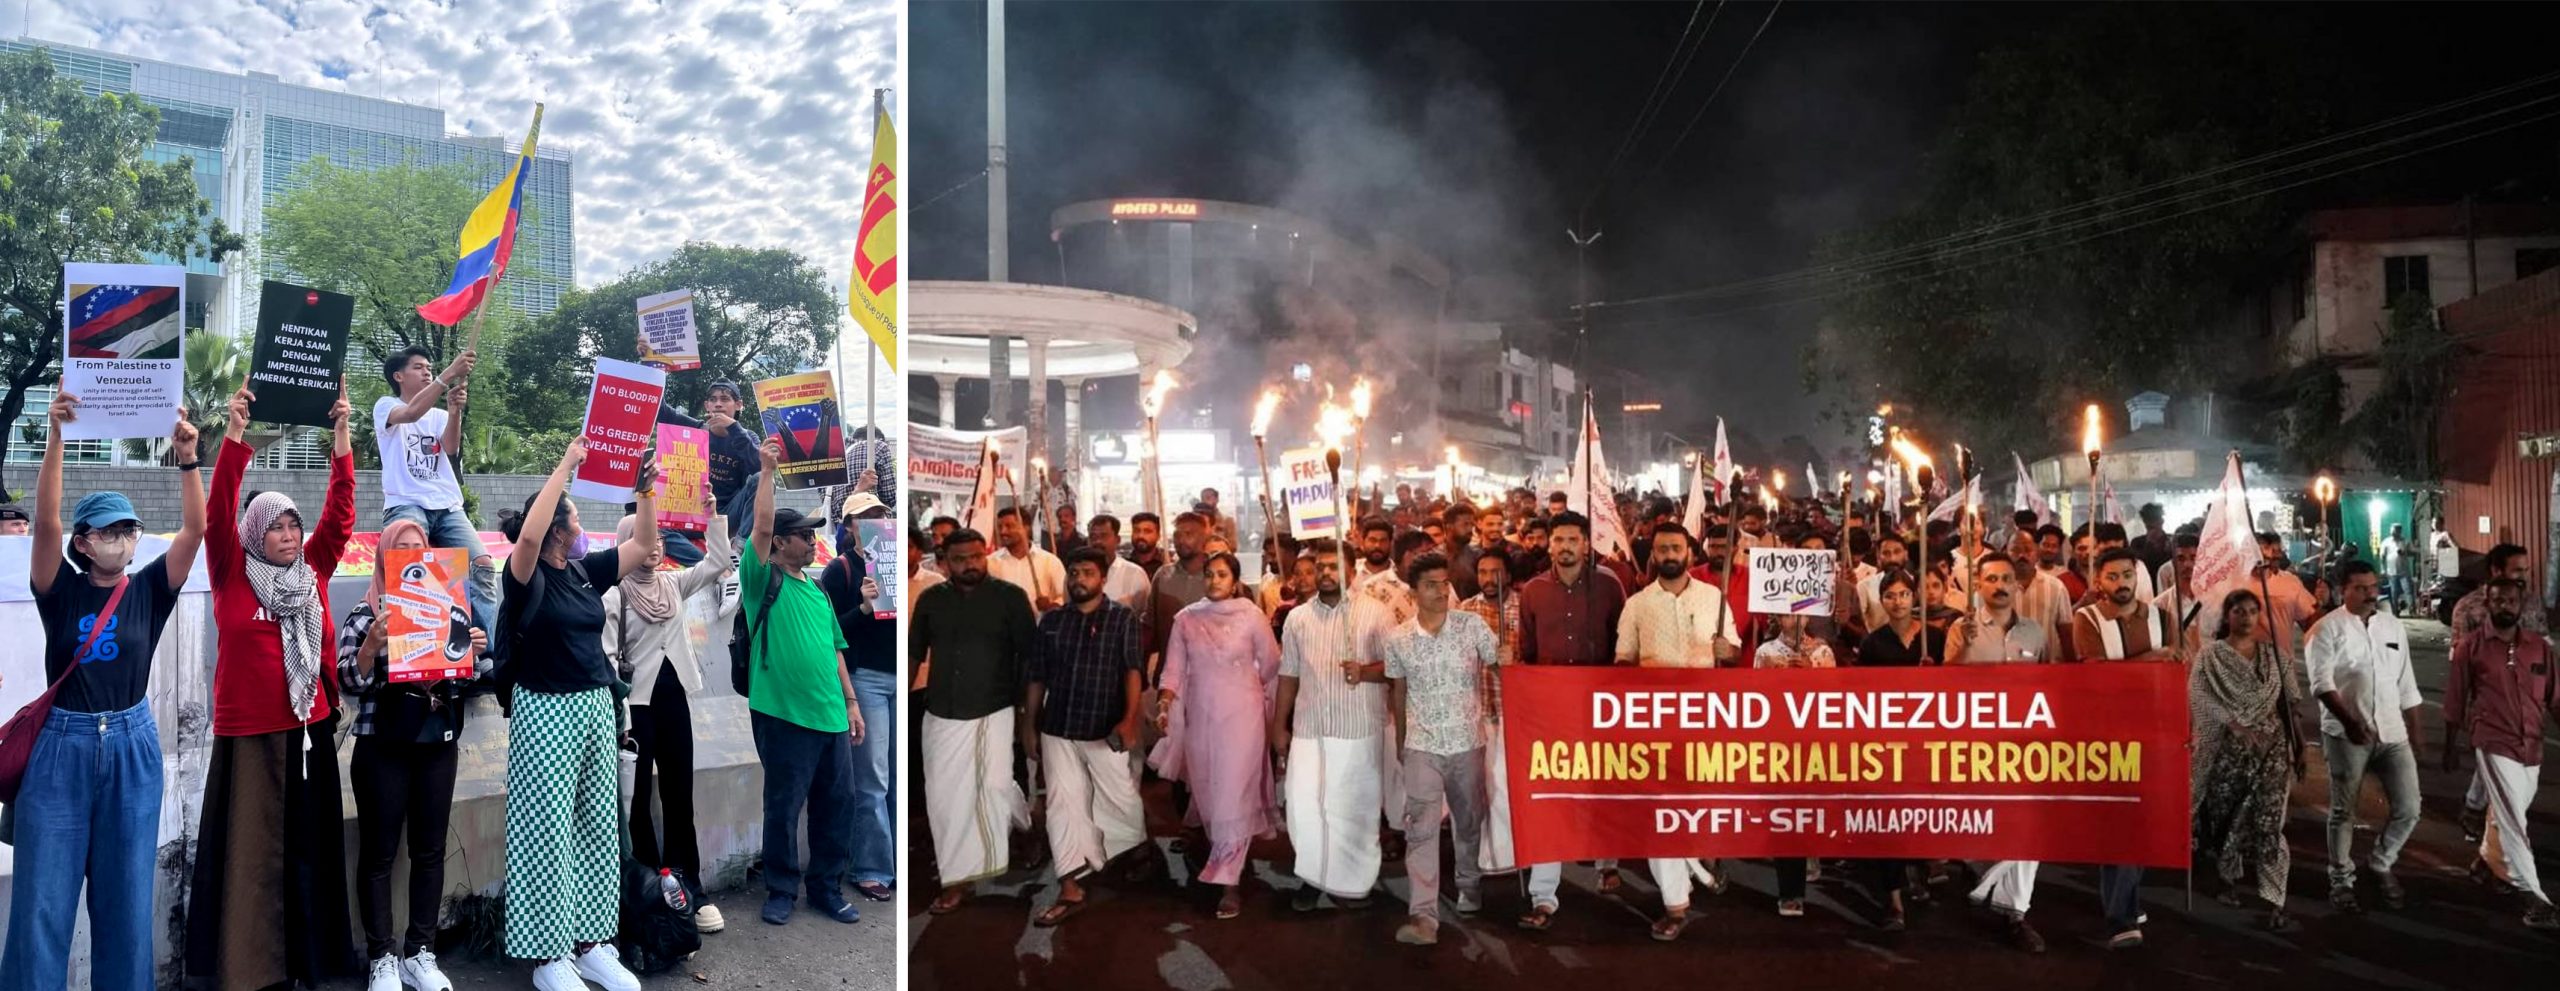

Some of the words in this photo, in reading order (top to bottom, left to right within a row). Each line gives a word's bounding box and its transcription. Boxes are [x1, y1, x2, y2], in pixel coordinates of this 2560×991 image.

[1160, 202, 1196, 214] PLAZA
[281, 323, 328, 338] HENTIKAN
[876, 312, 884, 321] of
[882, 316, 897, 339] Peo
[274, 335, 304, 347] KERJA
[306, 340, 331, 352] SAMA
[282, 350, 321, 363] DENGAN
[76, 361, 103, 370] From
[107, 361, 158, 370] Palestine
[160, 361, 171, 370] to
[267, 361, 330, 377] IMPERIALISME
[96, 376, 152, 384] Venezuela
[253, 372, 295, 385] AMERIKA
[602, 385, 616, 395] NO
[618, 388, 647, 402] BLOOD
[648, 395, 659, 404] FOR
[797, 389, 825, 398] VENEZUELA!
[624, 404, 641, 414] OIL!
[590, 424, 604, 435] US
[606, 428, 638, 442] GREED
[672, 440, 699, 457] TOLAK
[609, 460, 630, 471] WAR
[662, 453, 707, 473] INTERVENSI
[667, 468, 701, 486] MILITER
[664, 483, 691, 499] ASING
[881, 541, 897, 551] LAW
[877, 563, 897, 574] IMPE
[1592, 692, 1771, 728] DEFEND
[1783, 692, 2056, 728] VENEZUELA
[1529, 740, 1672, 781] AGAINST
[1685, 742, 1908, 783] IMPERIALIST
[1923, 741, 2141, 783] TERRORISM
[1845, 808, 1994, 834] MALAPPURAM
